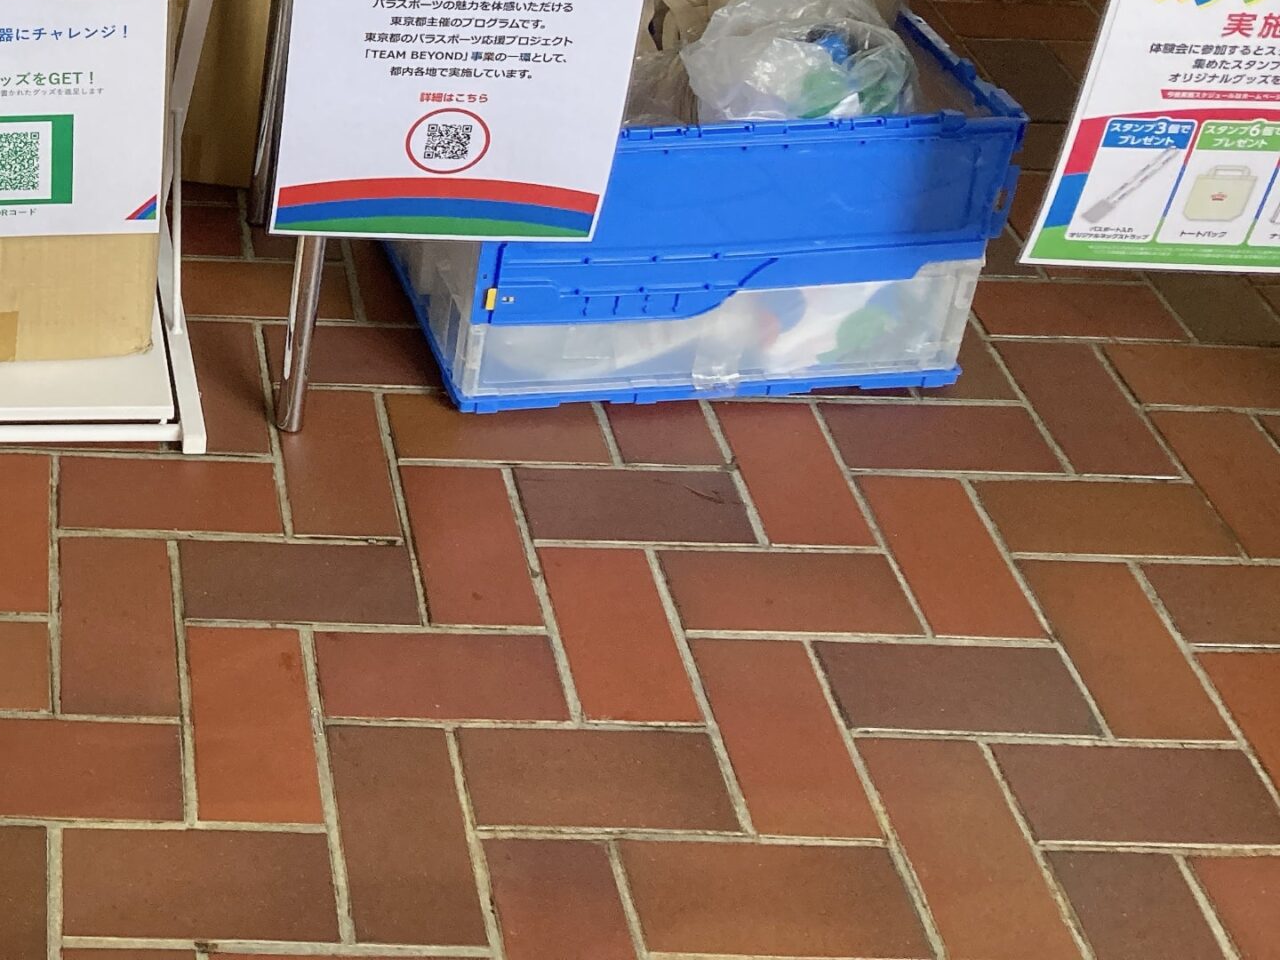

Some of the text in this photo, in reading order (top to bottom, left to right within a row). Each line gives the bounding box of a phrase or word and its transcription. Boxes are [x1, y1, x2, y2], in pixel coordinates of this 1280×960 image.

[390, 15, 547, 30] 東京都主催のプログラムです。
[390, 66, 533, 80] 都内各地で実施しています。
[419, 92, 489, 104] 詳細はこちら
[1119, 135, 1175, 147] プレゼント
[1213, 138, 1268, 148] プレゼント
